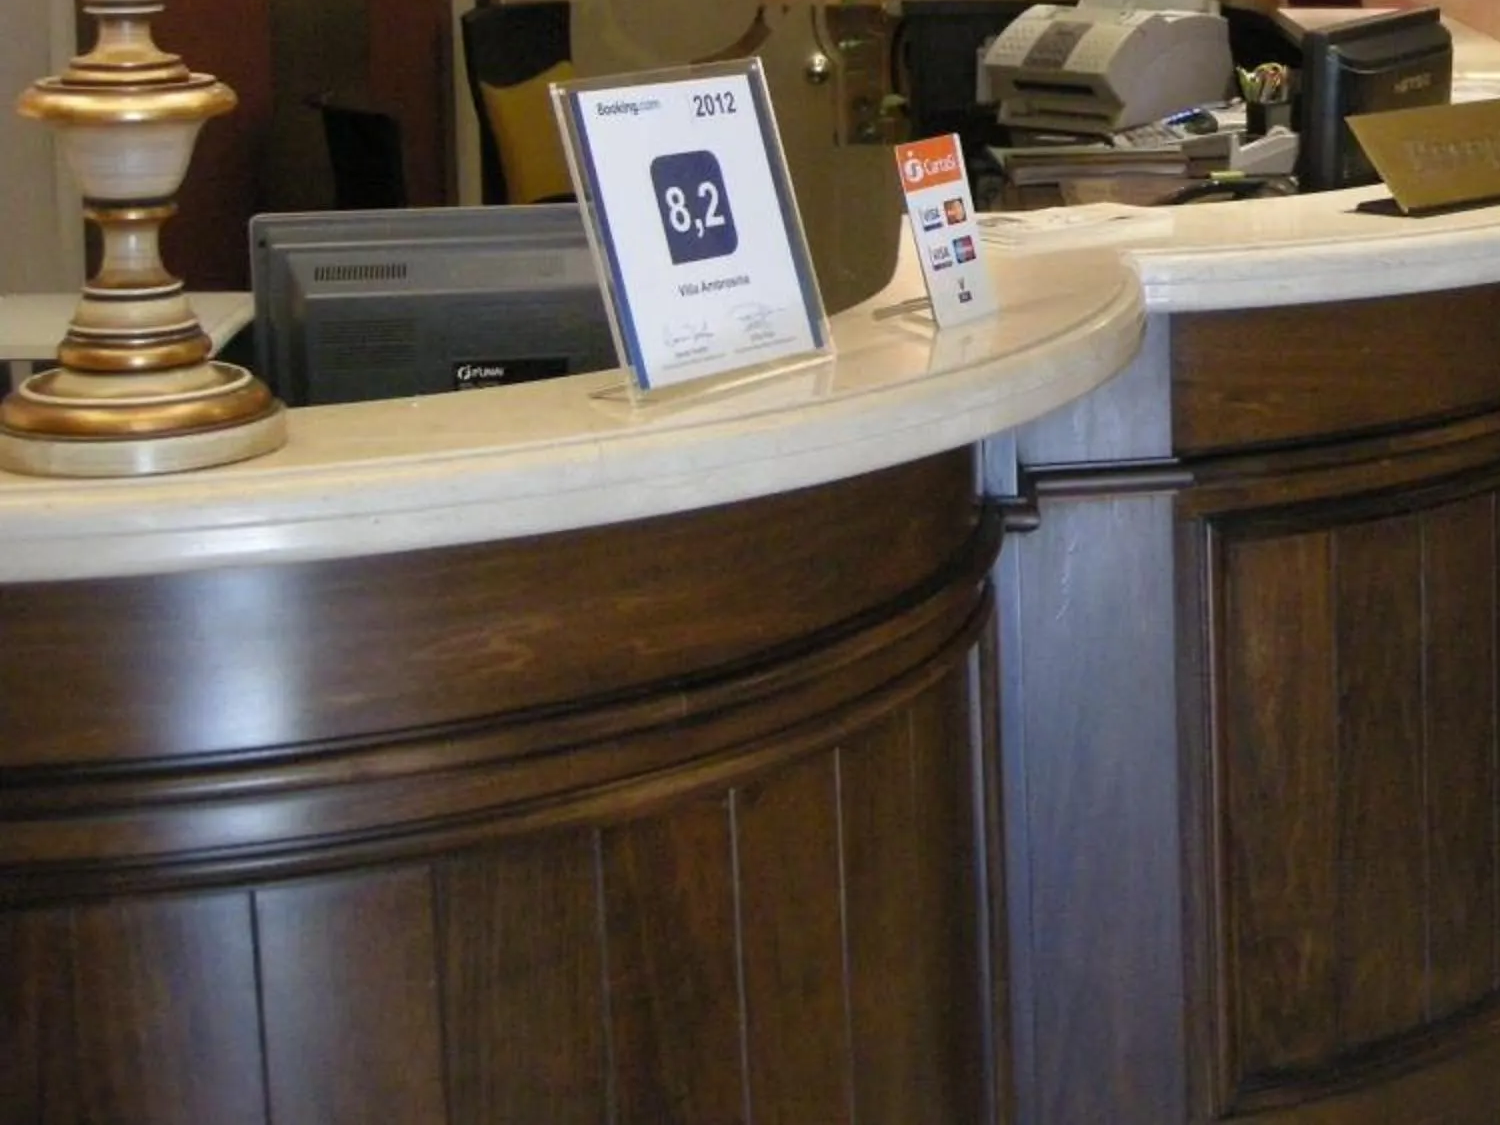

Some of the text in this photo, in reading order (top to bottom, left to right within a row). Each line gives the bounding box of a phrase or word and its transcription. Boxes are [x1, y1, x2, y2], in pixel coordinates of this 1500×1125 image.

[597, 100, 659, 116] Booking.com
[694, 91, 736, 117] 2012
[665, 181, 725, 238] 8,2
